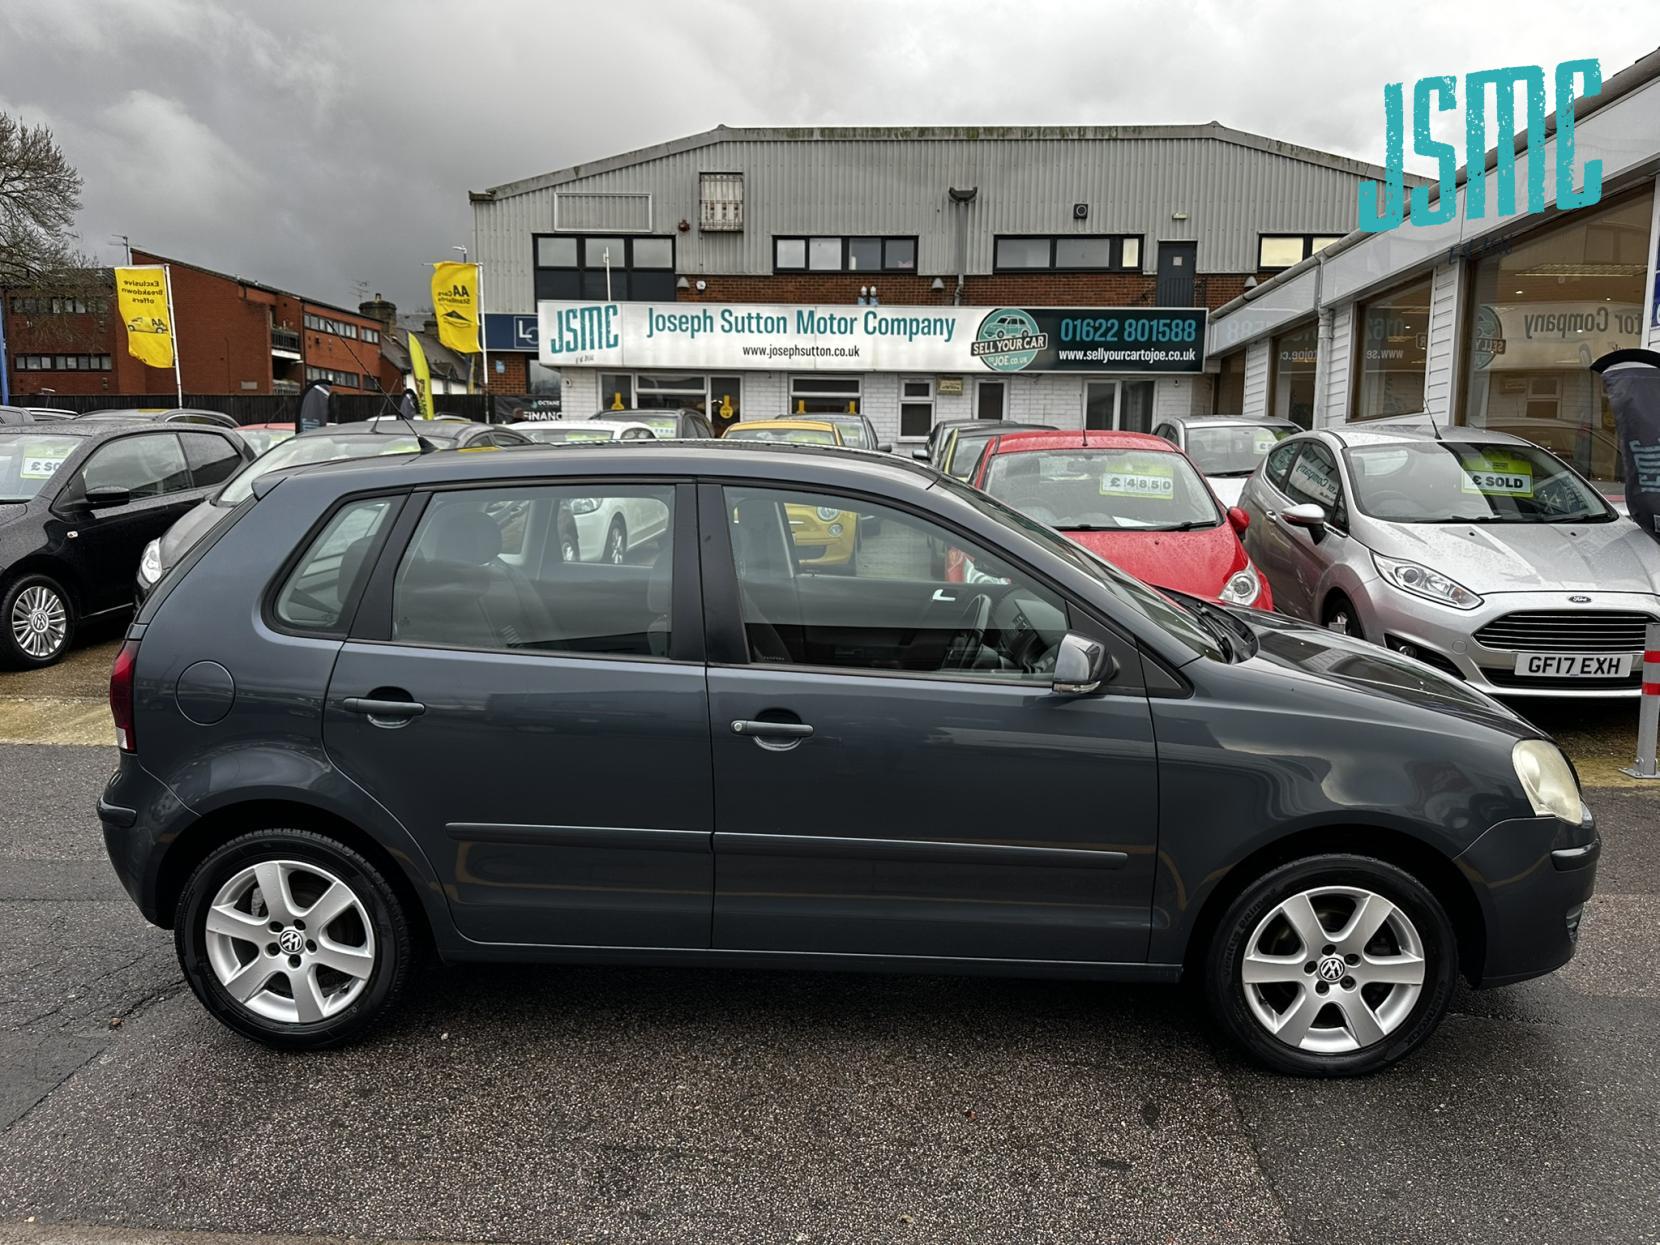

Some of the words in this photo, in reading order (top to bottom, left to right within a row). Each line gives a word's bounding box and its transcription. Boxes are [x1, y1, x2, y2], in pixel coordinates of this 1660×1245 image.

[550, 304, 619, 354] JSMC
[646, 307, 714, 339] Joseph
[720, 308, 787, 334] Sutton
[796, 309, 858, 335] Motor
[863, 310, 956, 343] Company
[1060, 318, 1118, 343] 01622
[1123, 318, 1196, 343] 801588
[742, 344, 860, 360] www.josephsutton.co.uk
[973, 341, 995, 355] SELL
[996, 338, 1023, 352] YOUR
[1023, 336, 1044, 349] CAR
[1059, 348, 1195, 364] www.sellyourcartojoe.co.uk
[1126, 478, 1171, 490] 4850
[1485, 476, 1523, 488] SOLD
[1528, 656, 1576, 674] GF17
[1579, 657, 1621, 675] EXH
